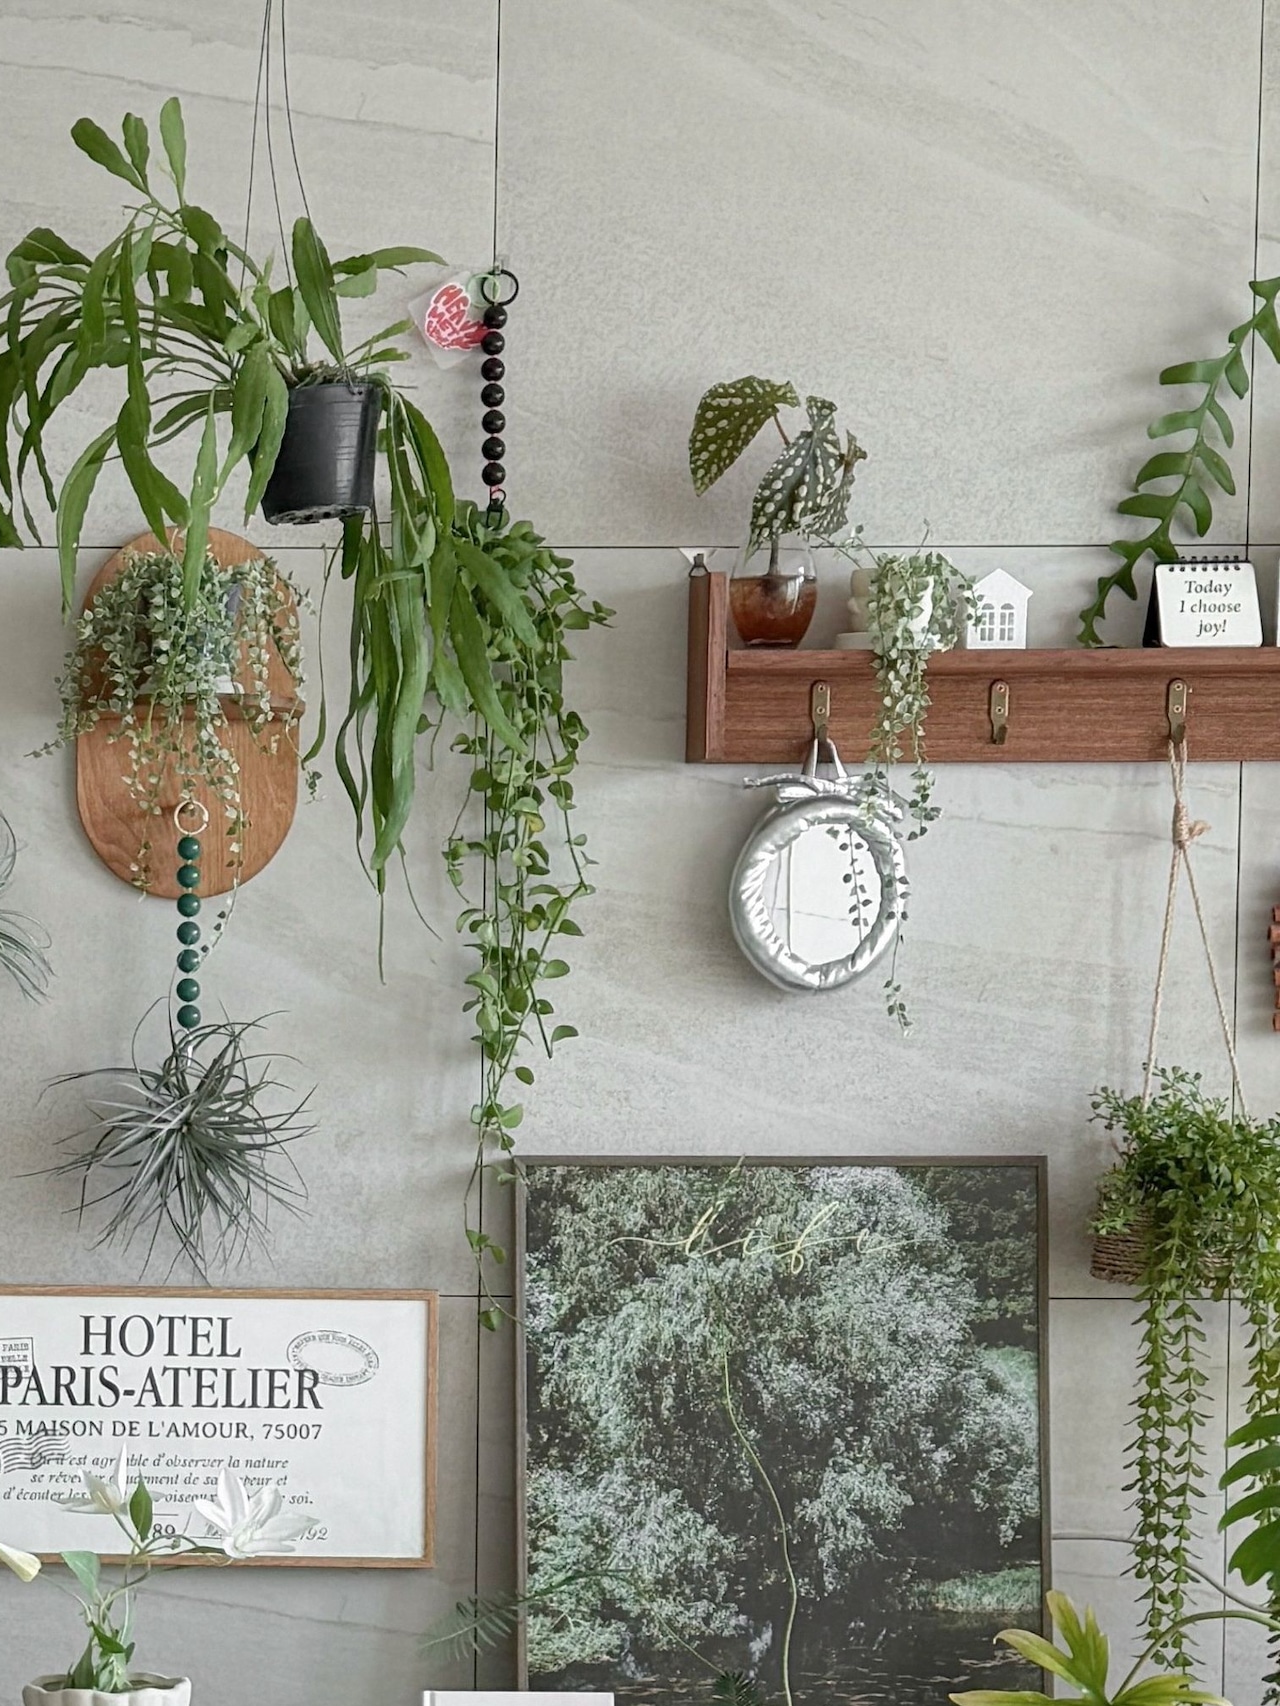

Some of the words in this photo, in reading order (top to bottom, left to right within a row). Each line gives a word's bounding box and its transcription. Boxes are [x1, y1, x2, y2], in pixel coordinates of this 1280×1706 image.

[1184, 580, 1232, 597] Today
[1180, 600, 1185, 613] I
[1190, 599, 1241, 613] choose
[1196, 619, 1227, 637] joy!
[79, 1314, 242, 1359] HOTEL
[15, 1419, 104, 1438] MAISON
[112, 1420, 141, 1438] DE
[148, 1420, 255, 1441] L'AMOUR,
[262, 1423, 323, 1440] 75007
[69, 1454, 87, 1466] est
[92, 1453, 149, 1470] agrble
[153, 1452, 224, 1468] d'observer
[228, 1455, 240, 1468] la
[245, 1456, 289, 1469] nature
[30, 1474, 45, 1484] se
[184, 1472, 200, 1486] de
[203, 1476, 218, 1485] sa
[276, 1475, 288, 1486] et
[2, 1486, 64, 1500] d'écouter
[289, 1491, 314, 1505] soi.
